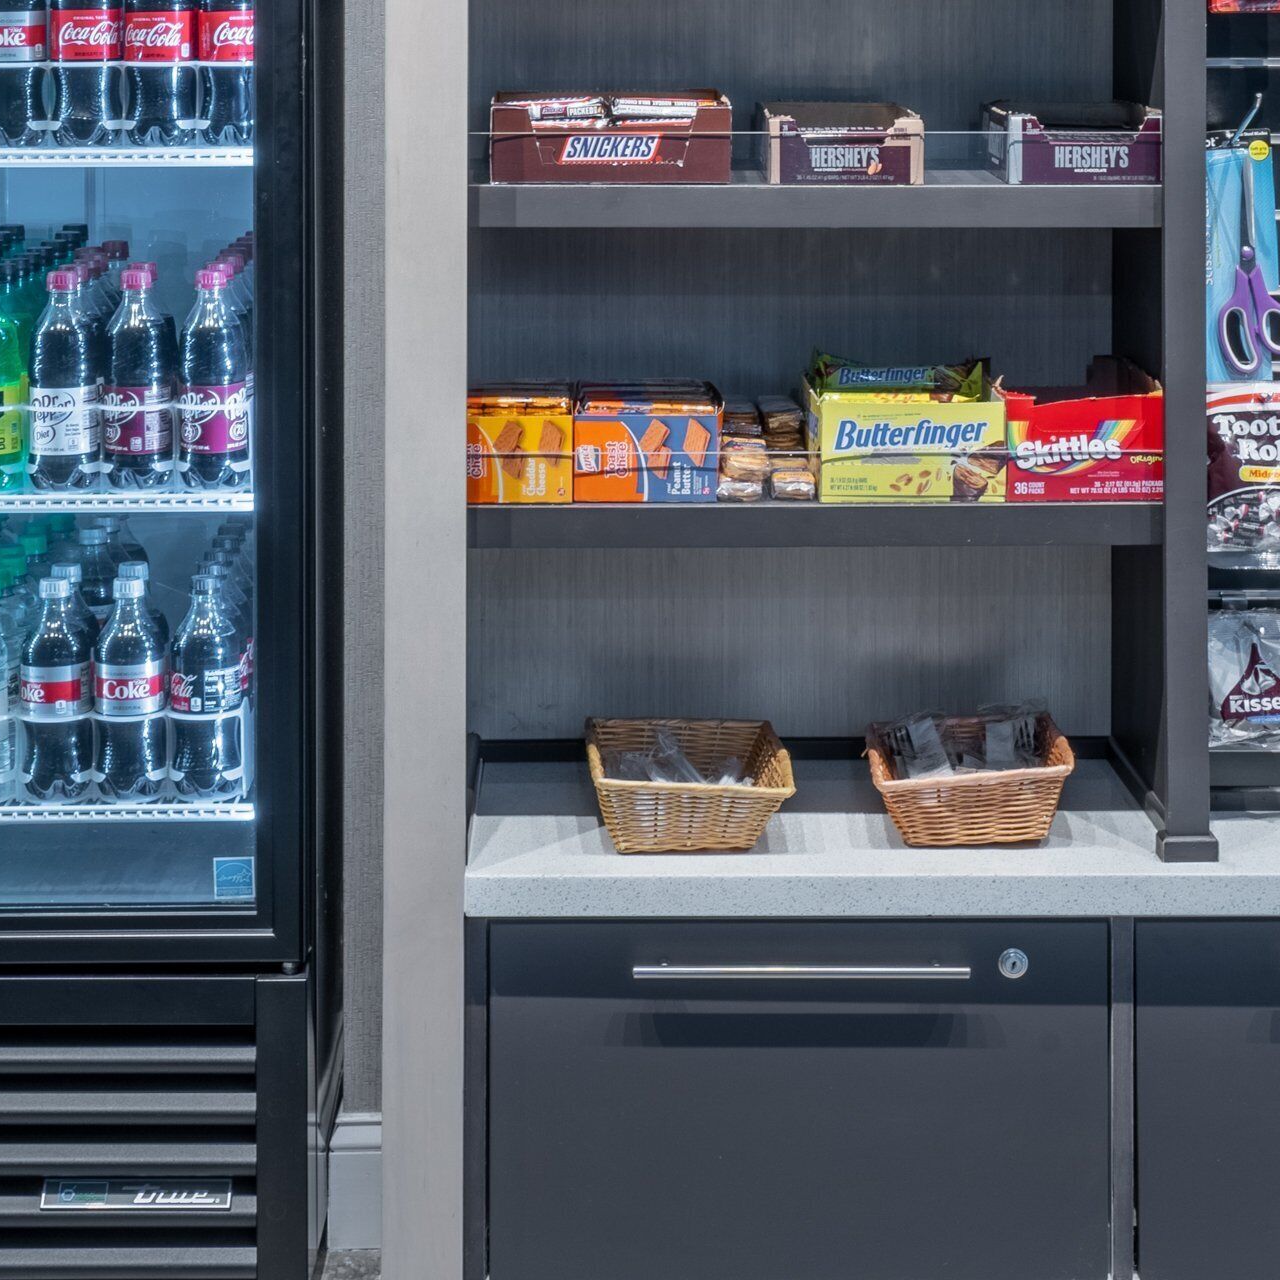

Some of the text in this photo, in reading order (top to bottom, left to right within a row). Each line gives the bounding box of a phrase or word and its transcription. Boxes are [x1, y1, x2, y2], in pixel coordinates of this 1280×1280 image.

[58, 20, 119, 46] Coca-Cola
[125, 22, 183, 47] Coca-Cola
[566, 135, 658, 158] SNICKERS
[811, 147, 880, 168] HERSHEY'S
[1054, 145, 1130, 169] HERSHEY'S
[838, 367, 927, 385] Butterfinger
[36, 429, 51, 440] Diet
[834, 417, 987, 451] Butterfinger
[604, 441, 617, 479] Toast
[616, 441, 628, 479] Chee
[1016, 435, 1122, 469] Skittles
[526, 457, 536, 496] Cheddar
[536, 463, 545, 496] Cheese
[671, 461, 681, 496] Peanut
[681, 464, 691, 496] Butter
[1014, 481, 1028, 495] 36
[103, 680, 151, 700] Coke
